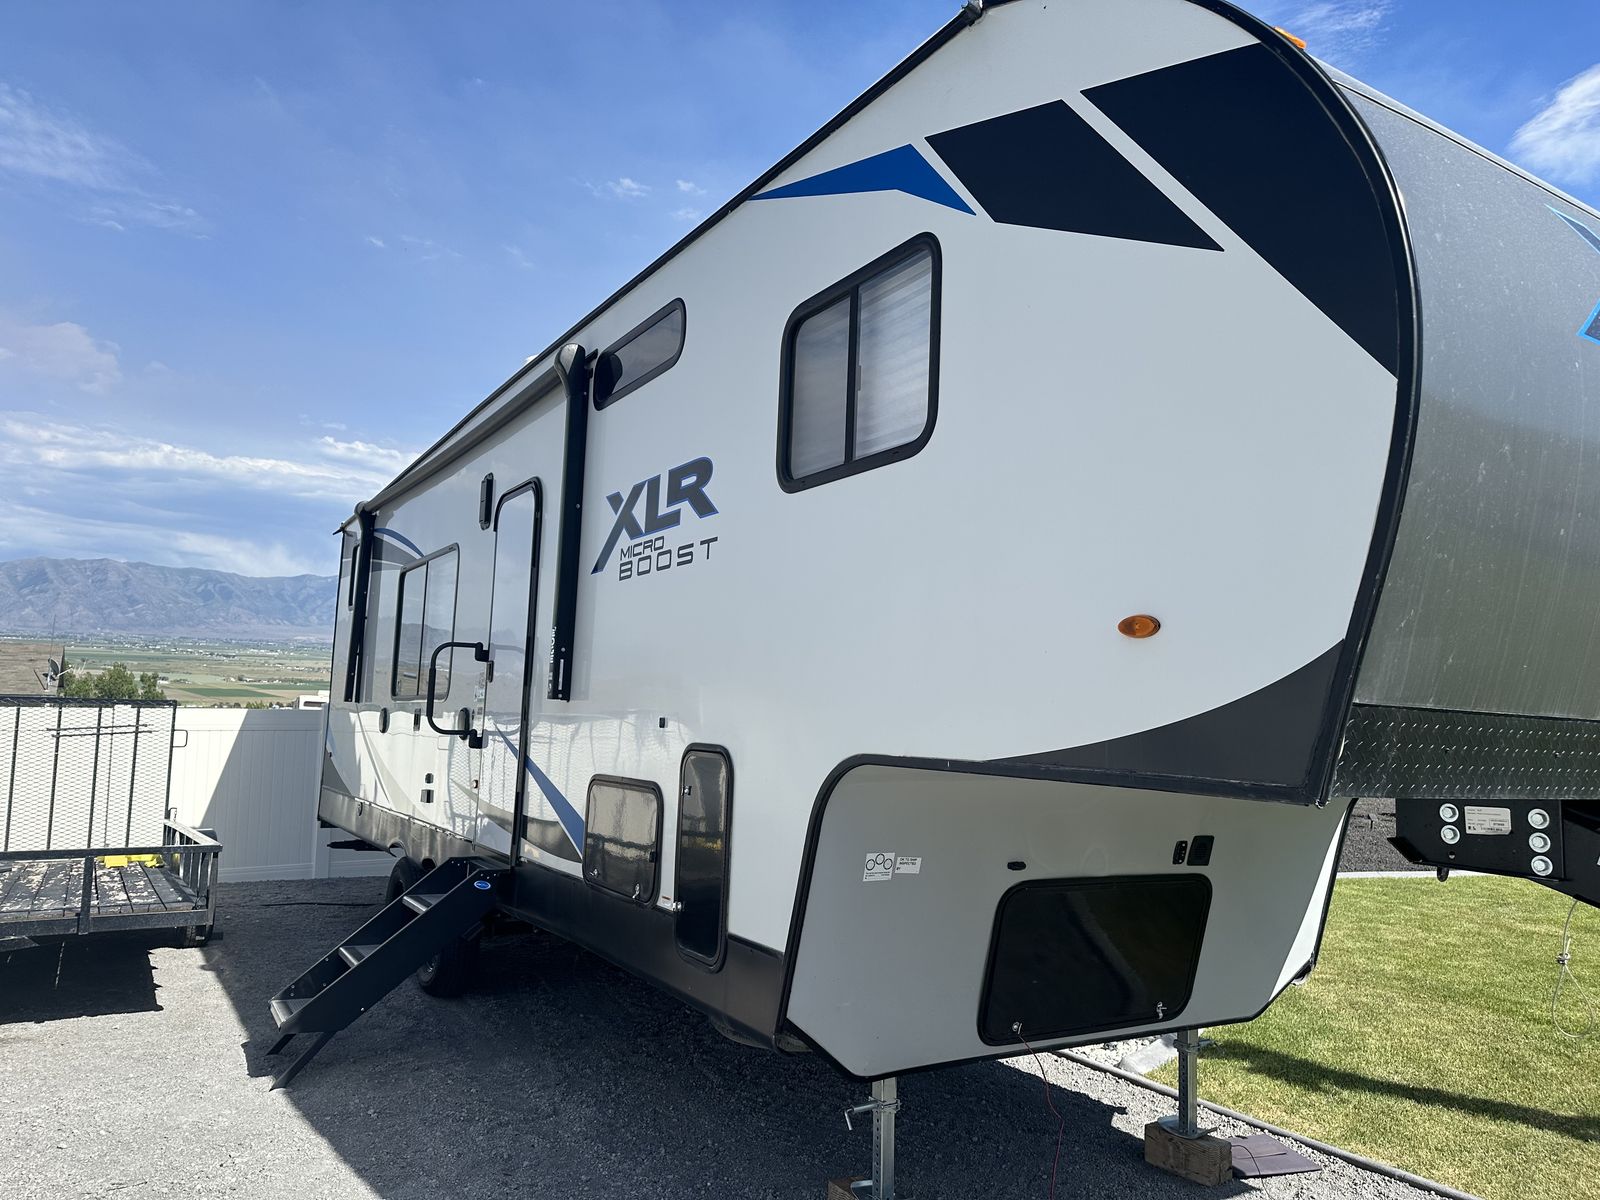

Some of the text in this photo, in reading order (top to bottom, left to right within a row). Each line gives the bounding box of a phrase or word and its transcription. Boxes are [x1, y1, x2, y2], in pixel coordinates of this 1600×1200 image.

[591, 456, 719, 575] XLR
[619, 536, 718, 581] BOOST
[620, 536, 665, 561] MICRO
